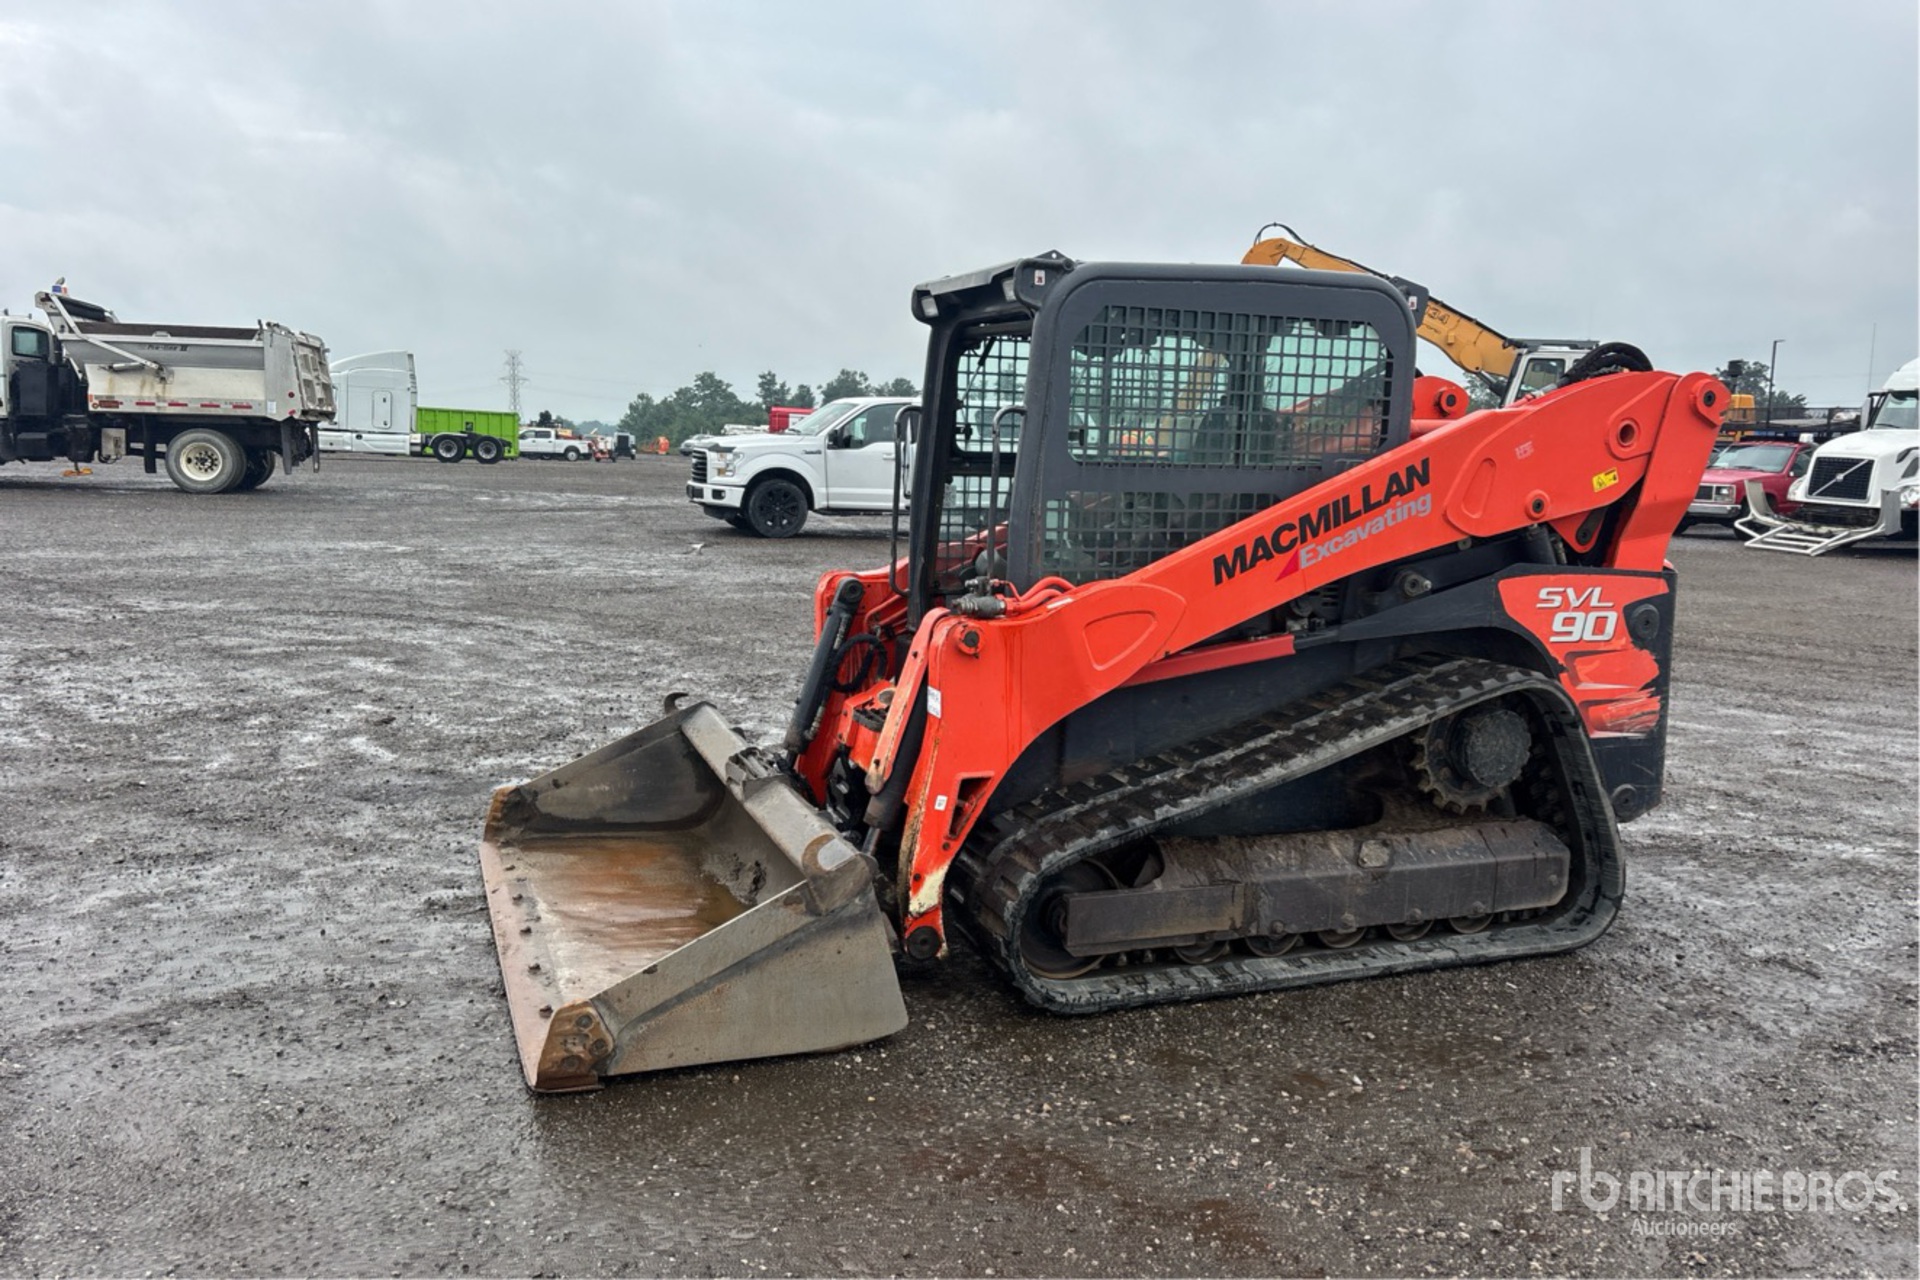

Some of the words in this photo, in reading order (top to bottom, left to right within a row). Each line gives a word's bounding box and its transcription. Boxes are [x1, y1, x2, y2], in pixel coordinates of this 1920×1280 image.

[1213, 457, 1430, 586] MACMILLAN
[1300, 493, 1432, 569] Excavating
[1536, 586, 1614, 608] SVL
[1549, 611, 1618, 642] 90
